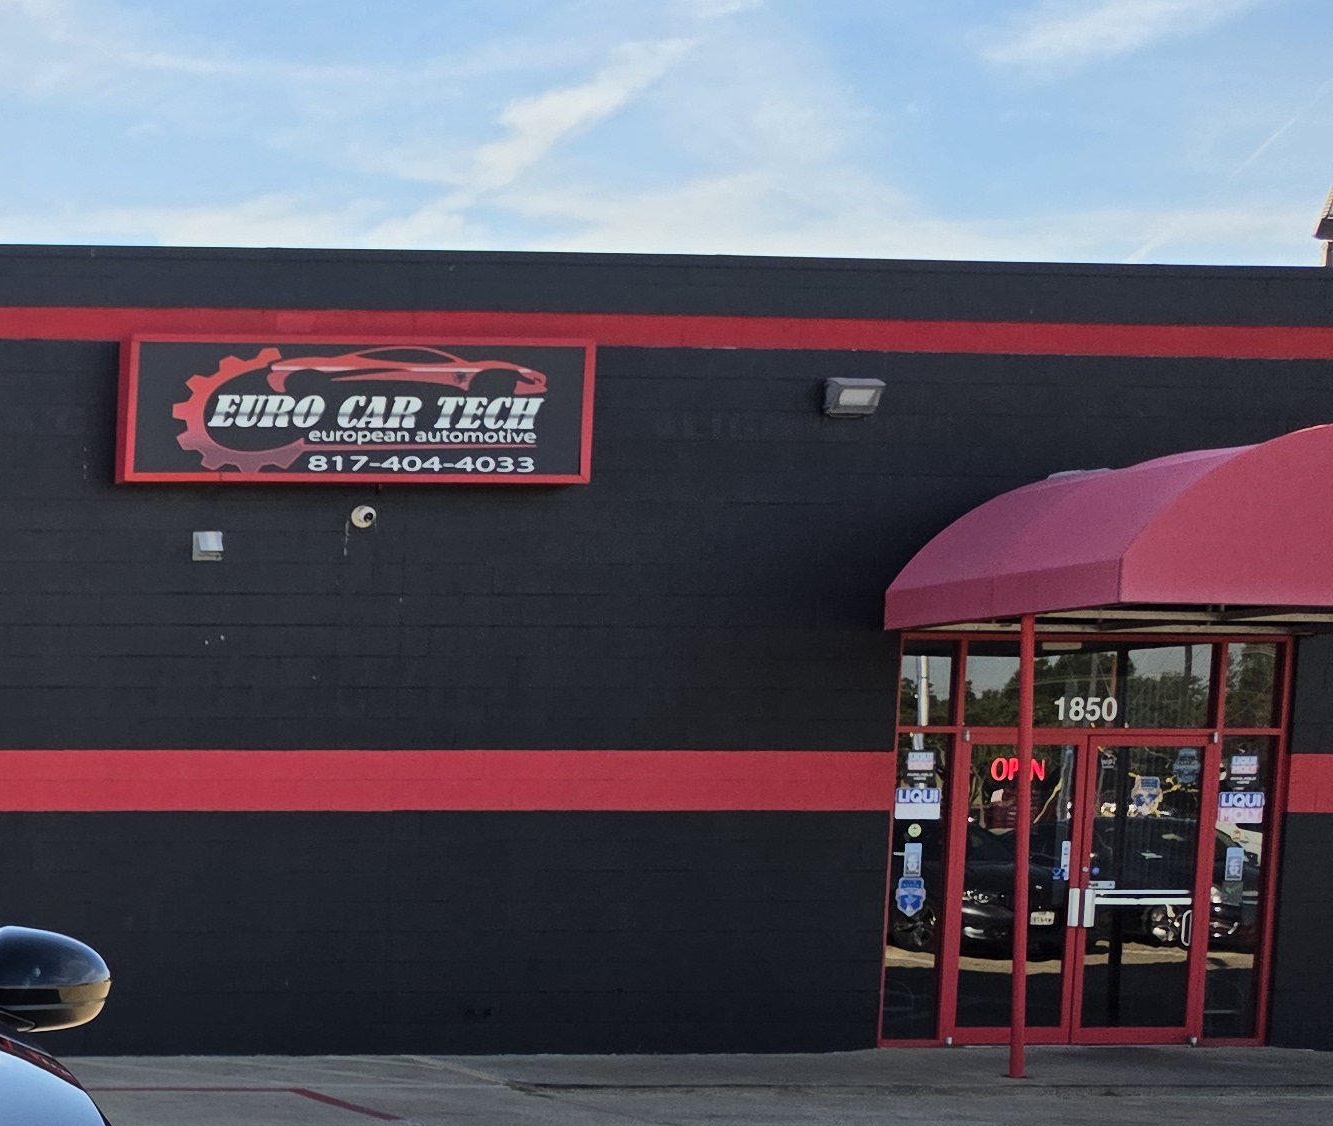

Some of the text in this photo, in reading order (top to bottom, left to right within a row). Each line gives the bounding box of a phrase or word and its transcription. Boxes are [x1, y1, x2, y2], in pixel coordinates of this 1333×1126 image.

[207, 394, 545, 431] EURO CAR TECH
[308, 427, 537, 445] european automotive
[307, 455, 535, 473] 817-404-4033
[1054, 696, 1118, 722] 1850
[990, 757, 1046, 781] OPN
[898, 788, 939, 803] LIQUI
[1220, 793, 1263, 808] LIQUI
